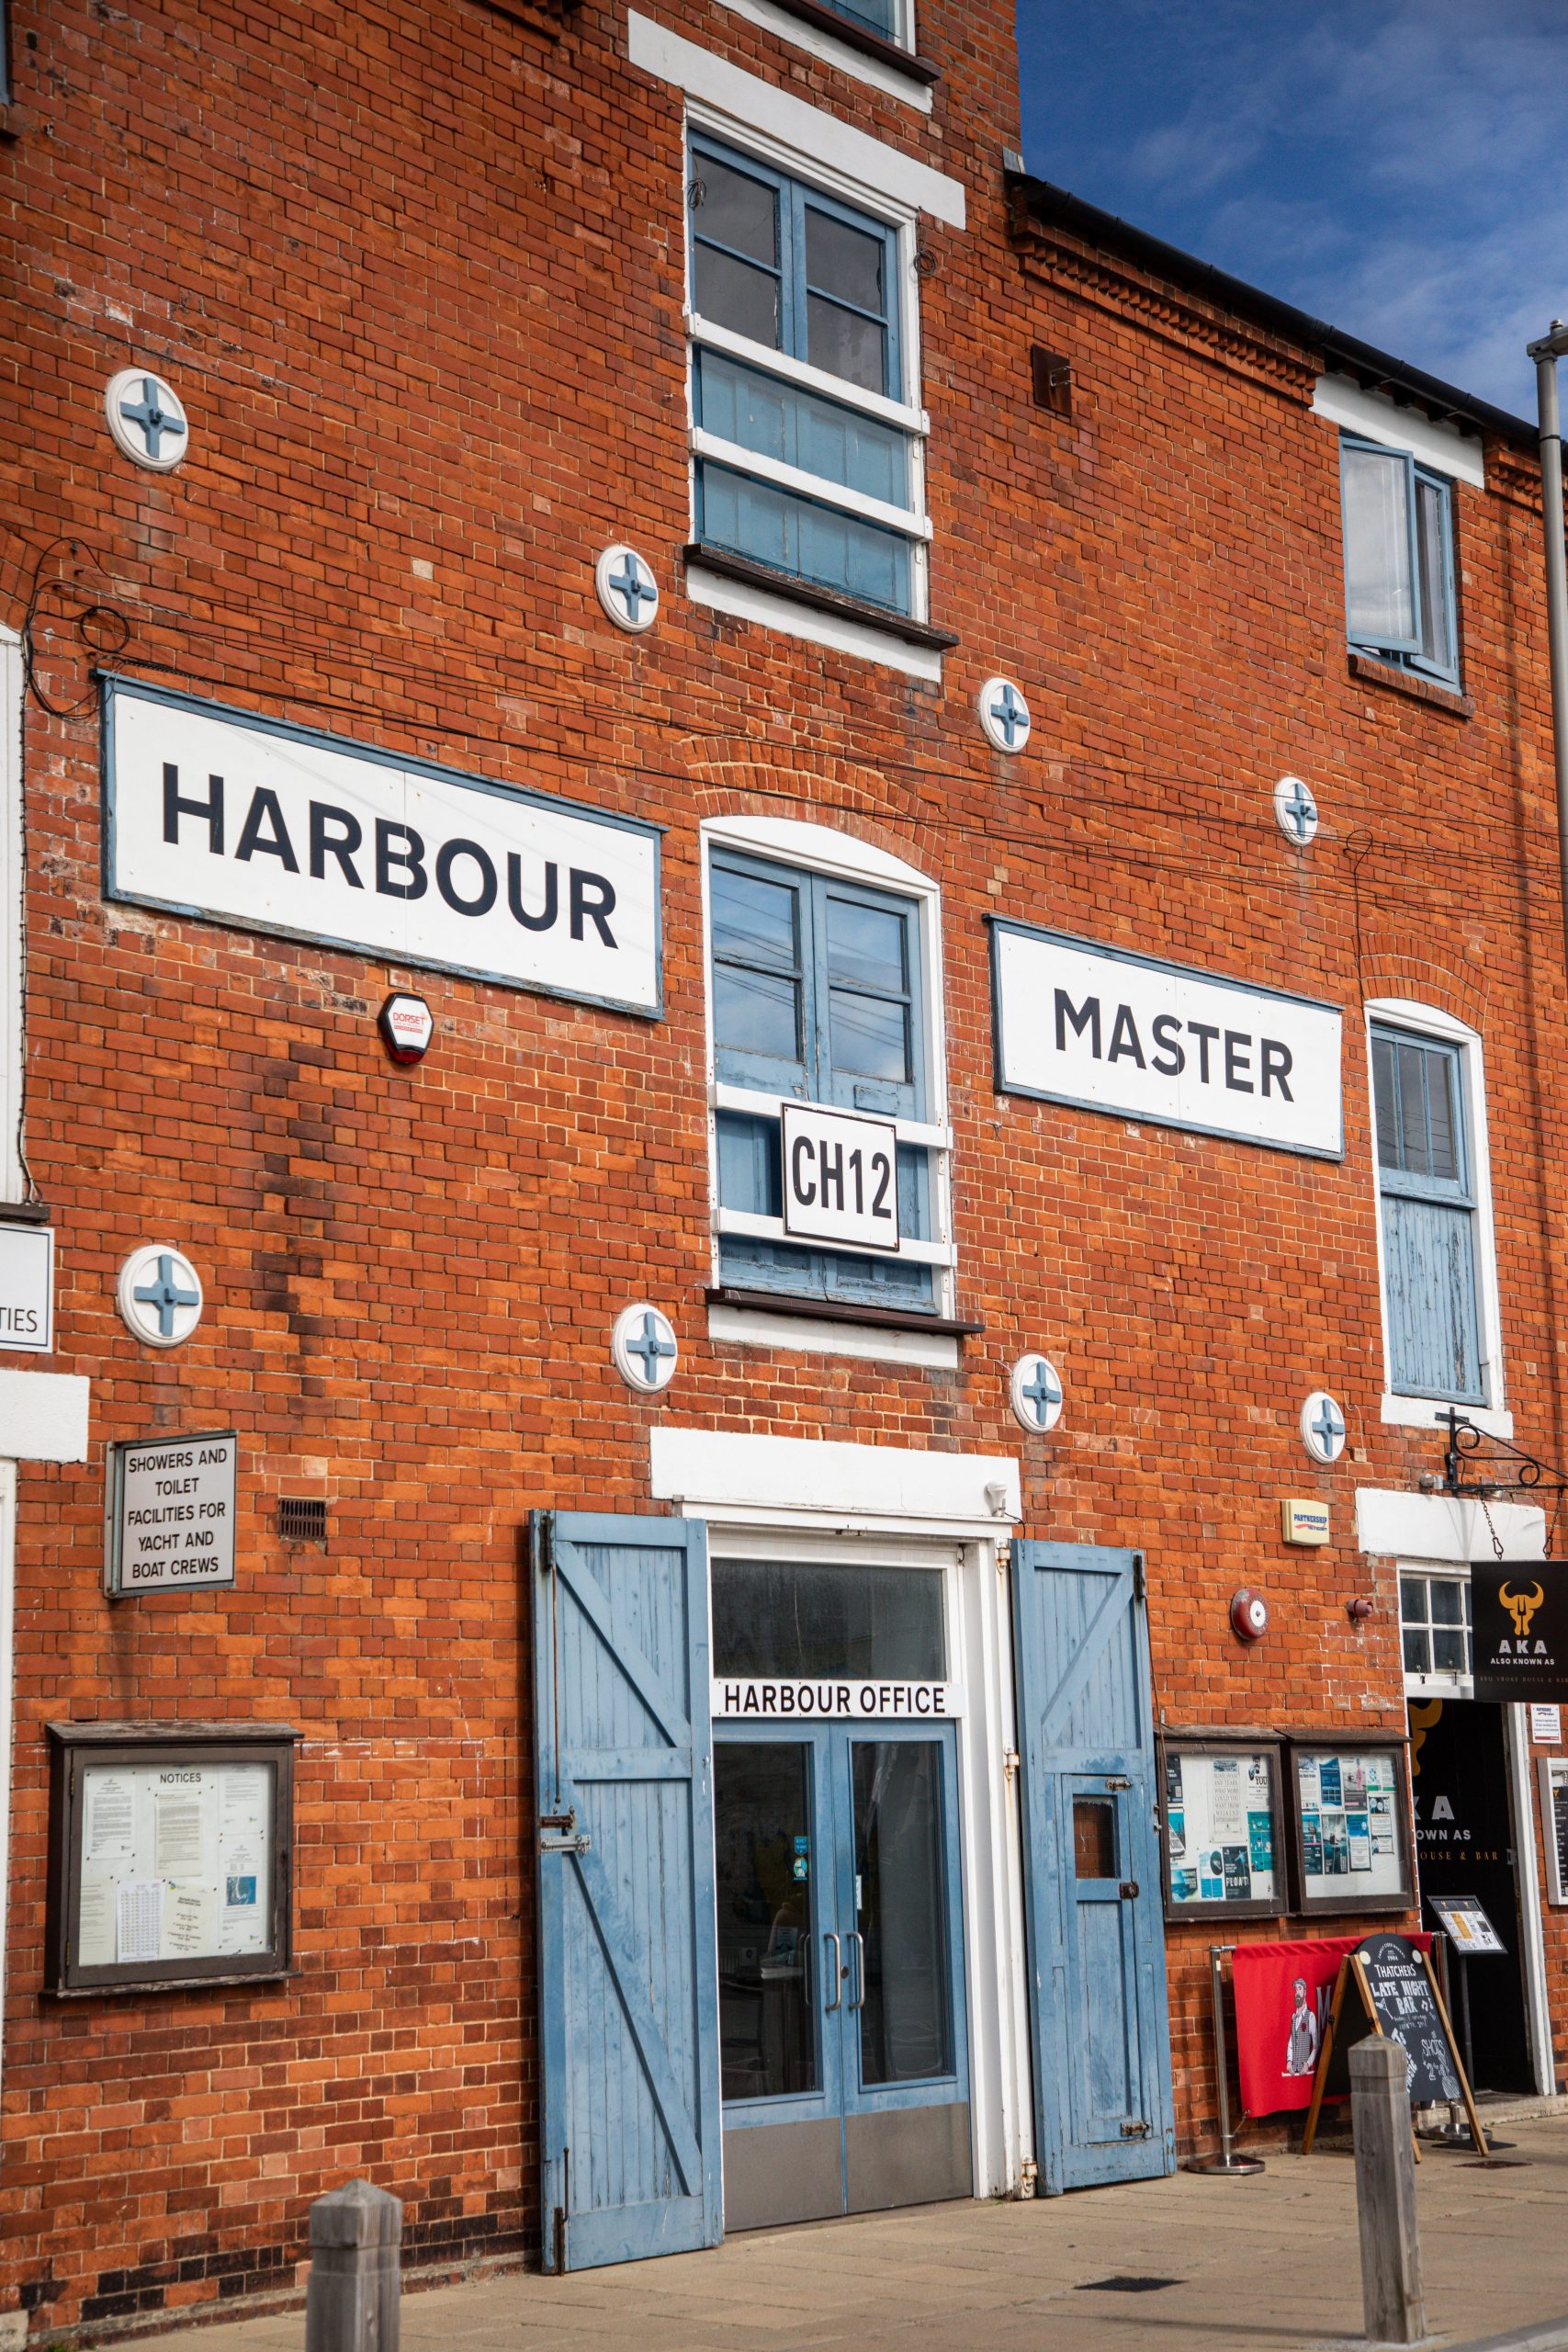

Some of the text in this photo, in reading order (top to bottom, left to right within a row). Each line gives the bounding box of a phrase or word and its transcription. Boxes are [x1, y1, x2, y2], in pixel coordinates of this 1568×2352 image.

[163, 762, 619, 950] HARBOUR
[393, 1012, 426, 1025] DORSET
[1054, 988, 1294, 1102] MASTER
[792, 1136, 892, 1219] CH12
[128, 1448, 227, 1473] SHOWERS AND
[155, 1477, 199, 1496] TOILET
[128, 1502, 226, 1526] FACILITIES FOR
[1293, 1513, 1327, 1524] PARTNERSHIP
[139, 1531, 214, 1552] YACHT AND
[131, 1556, 219, 1578] BOAT CREWS
[1499, 1640, 1547, 1654] AKA
[725, 1684, 945, 1714] HARBOUR OFFICE
[160, 1772, 201, 1783] NOTICES
[1255, 1776, 1268, 1785] YOU
[1453, 1829, 1471, 1840] AS
[1460, 1852, 1466, 1860] &
[1475, 1851, 1498, 1860] BAR
[1225, 1876, 1248, 1887] FLOAT
[1373, 1963, 1416, 1978] THATCHERS
[1370, 1980, 1428, 1997] LATE NIGHT
[1395, 1996, 1418, 2015] BAR
[1421, 2039, 1445, 2057] SHOTS
